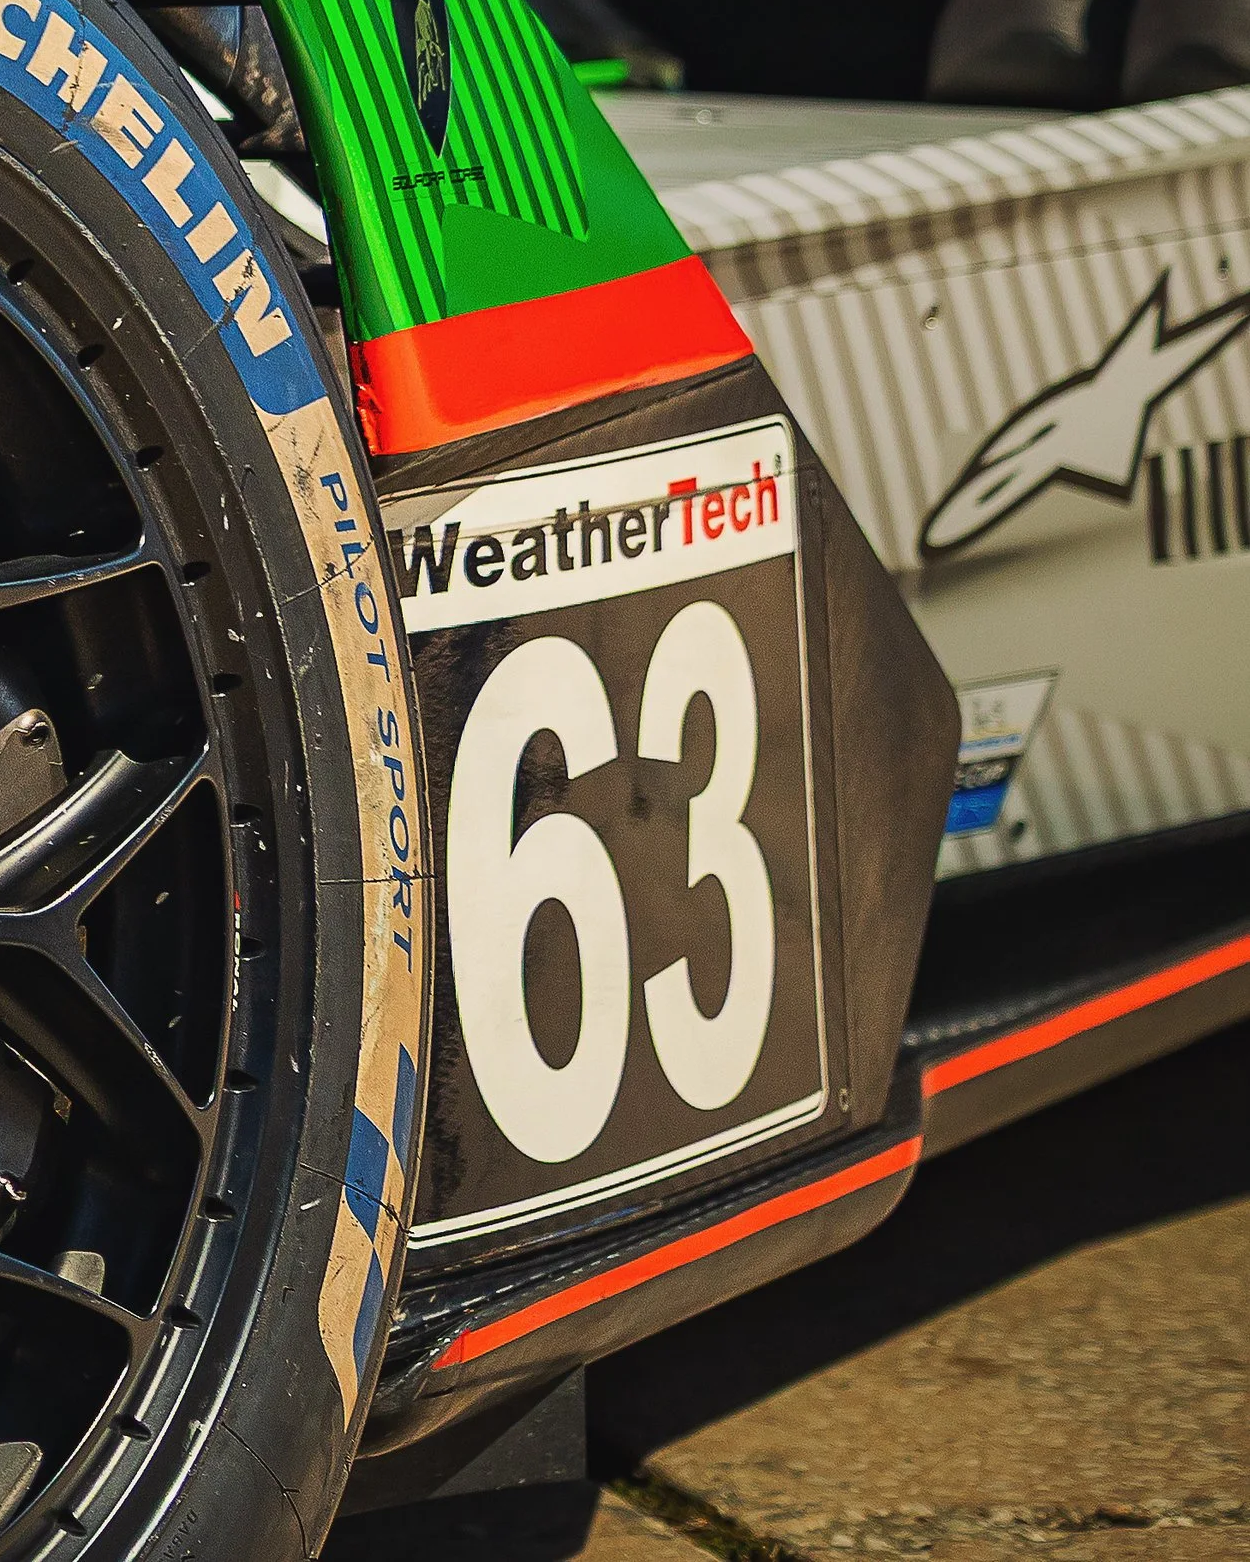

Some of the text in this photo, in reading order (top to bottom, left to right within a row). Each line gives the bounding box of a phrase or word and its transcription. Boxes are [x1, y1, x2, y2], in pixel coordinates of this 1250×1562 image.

[319, 471, 413, 973] PILOT SPORT
[386, 459, 781, 598] WeatherTech
[446, 599, 776, 1164] 63
